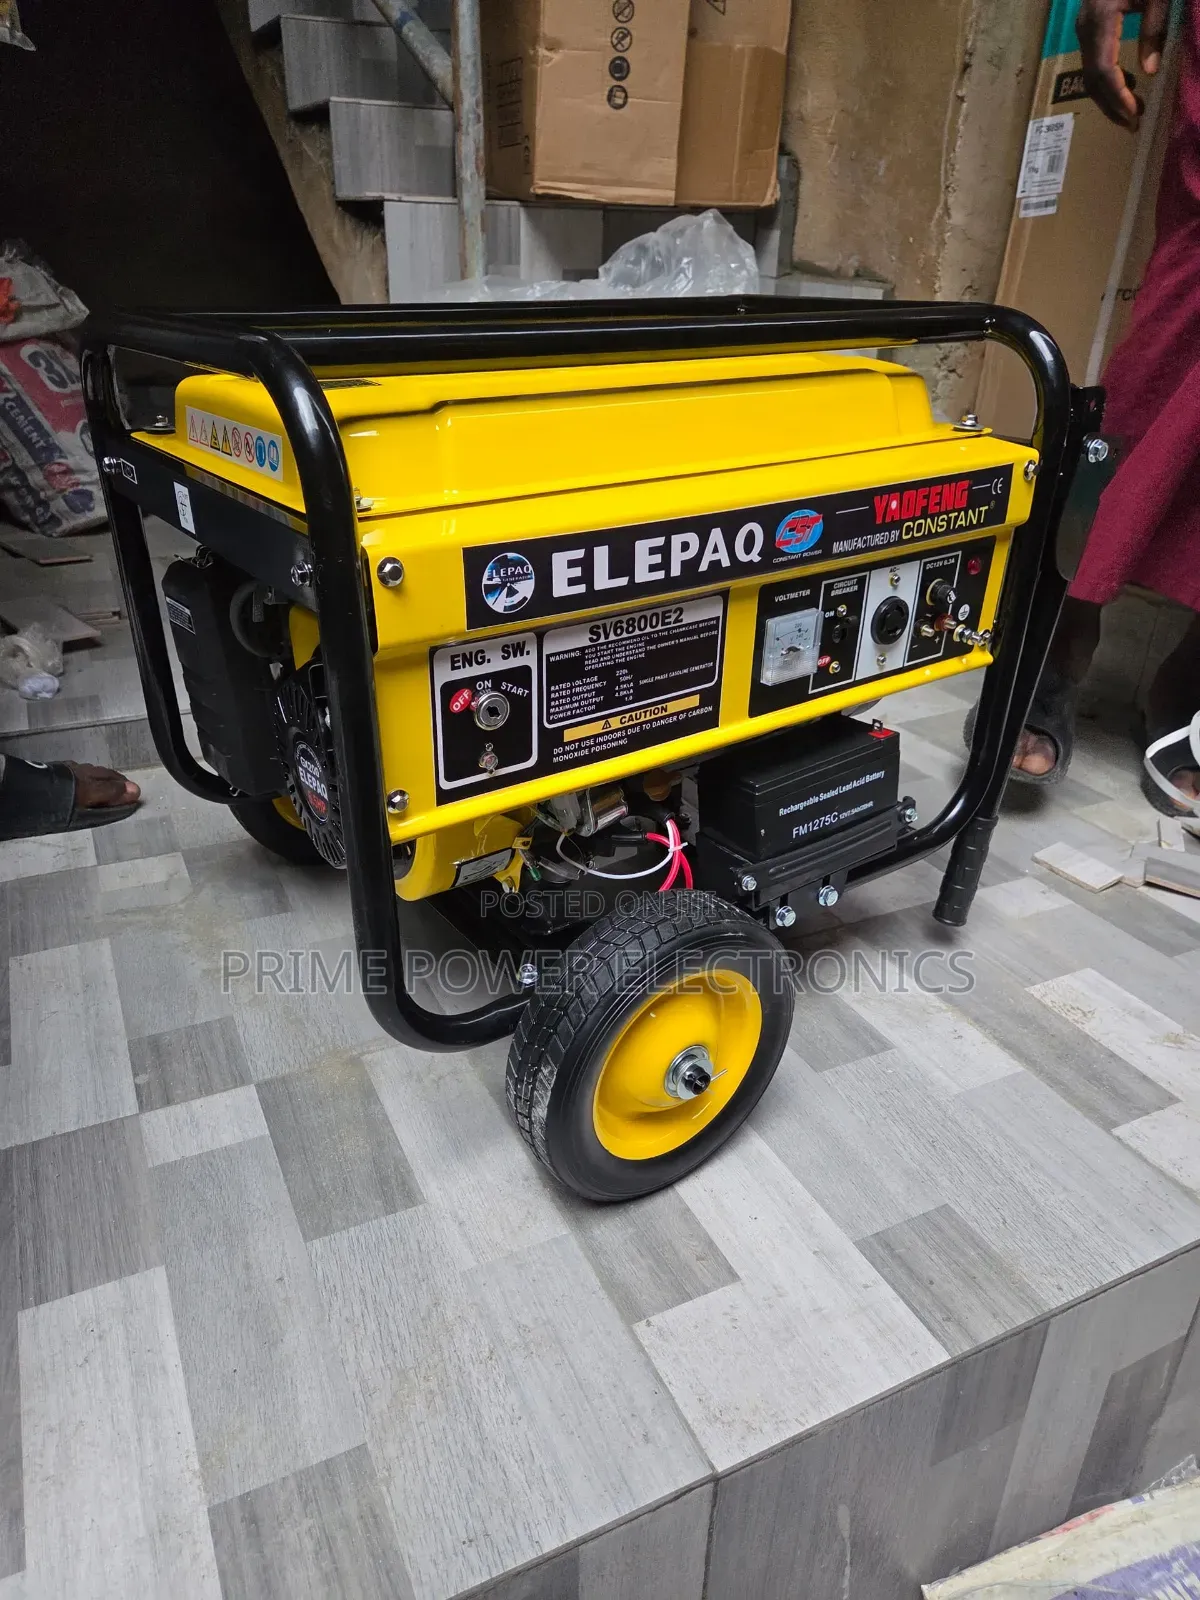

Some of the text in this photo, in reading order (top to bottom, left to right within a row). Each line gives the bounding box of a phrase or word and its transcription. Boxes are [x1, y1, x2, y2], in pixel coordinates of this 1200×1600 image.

[5, 396, 47, 449] CEMENT
[873, 480, 970, 524] YAOFENG
[832, 505, 989, 555] MANUFACTURED BY CONSTANT
[551, 521, 765, 599] ELEPAQ
[772, 549, 823, 564] CONSTANT POWER
[487, 564, 532, 578] ELEPAQ
[830, 585, 859, 597] BREAKER
[833, 578, 858, 589] CIRCUIT
[774, 589, 811, 602] VOLTMETER
[824, 610, 835, 618] ON
[588, 606, 684, 644] SV6800E2
[450, 640, 531, 671] ENG. SW.
[549, 650, 582, 663] WARNING:
[817, 656, 831, 666] OFF
[475, 679, 492, 690] ON
[500, 681, 529, 698] START
[550, 682, 571, 692] RATED
[550, 689, 571, 699] RATED
[572, 680, 607, 694] FREQUENCY
[452, 689, 470, 711] OFF
[549, 702, 580, 713] MAXIMUM
[580, 695, 605, 706] OUTPUT
[550, 697, 571, 707] RATED
[572, 691, 596, 701] OUTPUT
[549, 710, 572, 721] POWER
[572, 704, 596, 715] FACTOR
[619, 704, 668, 725] CAUTION
[553, 747, 564, 755] DO
[565, 742, 580, 752] NOT
[580, 739, 595, 748] USE
[596, 729, 626, 743] INDOORS
[627, 725, 641, 735] DUE
[642, 723, 651, 731] TO
[652, 715, 678, 728] DANGER
[687, 705, 713, 718] CARBON
[552, 738, 628, 764] MONOXIDE POISONING
[298, 766, 329, 802] ELEPAQ
[778, 770, 885, 817] Rechargeable Sealed Lead Acid Battery
[792, 811, 838, 839] FM1275C
